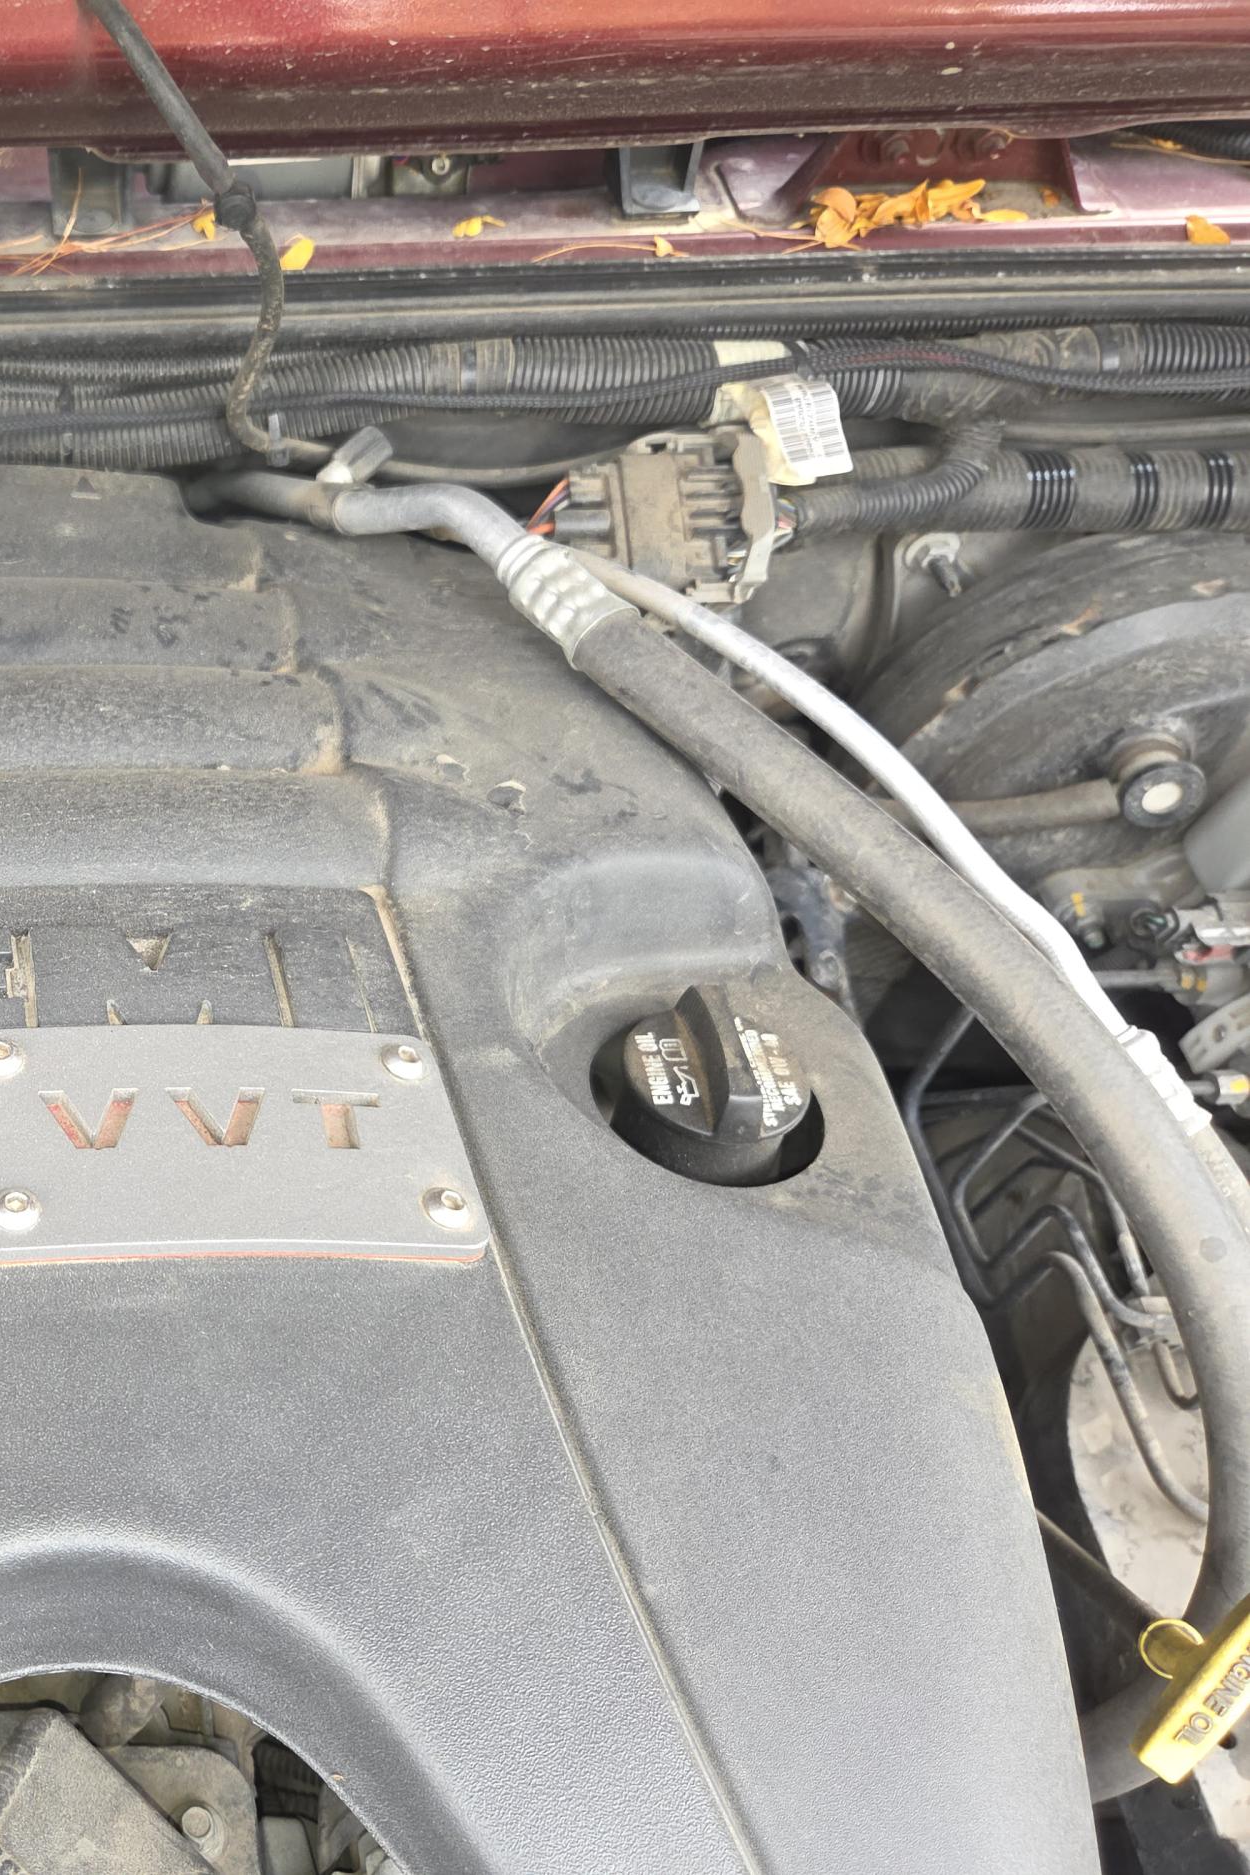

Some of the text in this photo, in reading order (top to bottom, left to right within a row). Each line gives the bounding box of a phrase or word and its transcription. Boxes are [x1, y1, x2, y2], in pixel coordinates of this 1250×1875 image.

[634, 1031, 674, 1106] ENGINE OIL
[777, 1081, 803, 1106] SAE
[37, 1086, 381, 1151] VVT
[1173, 1711, 1214, 1746] OIL
